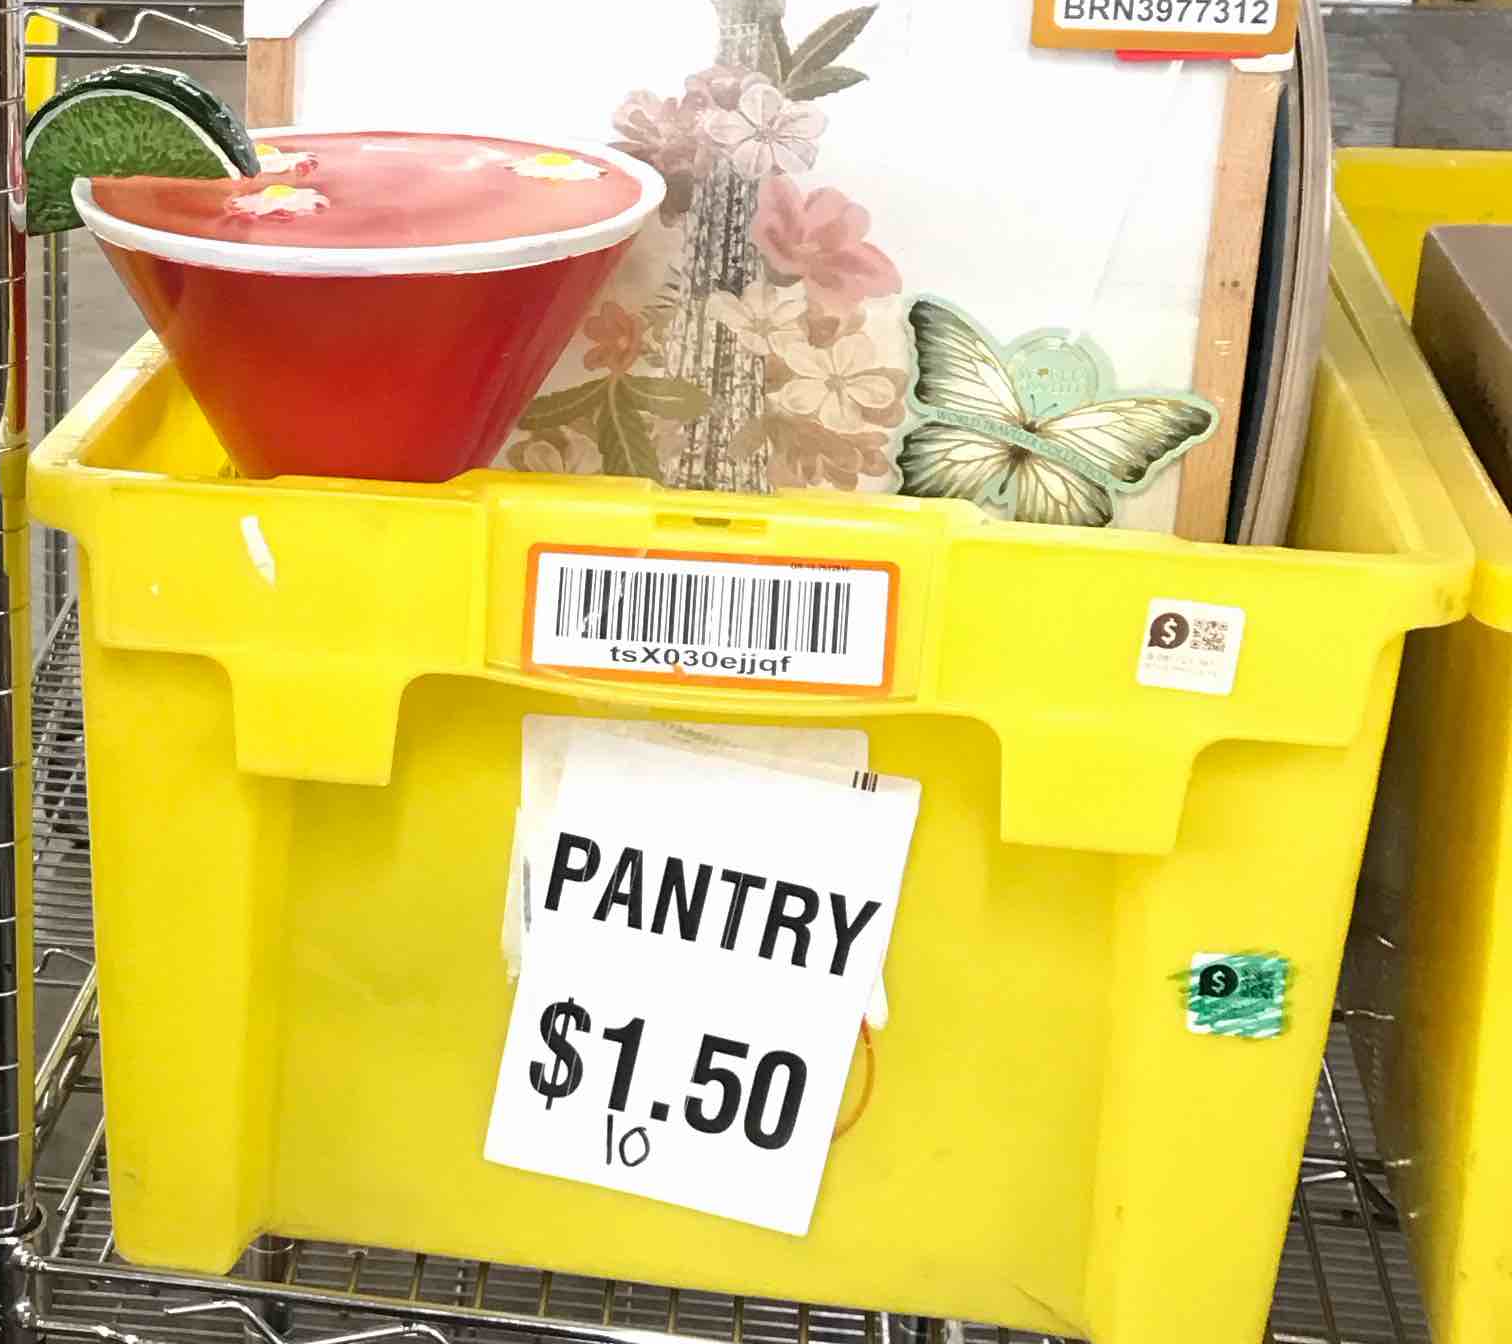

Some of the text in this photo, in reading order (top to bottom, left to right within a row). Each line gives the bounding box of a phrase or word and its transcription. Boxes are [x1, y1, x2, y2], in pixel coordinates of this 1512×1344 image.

[610, 645, 792, 676] tsX030ejjqf
[544, 832, 882, 976] PANTRY
[529, 996, 808, 1150] $1.50
